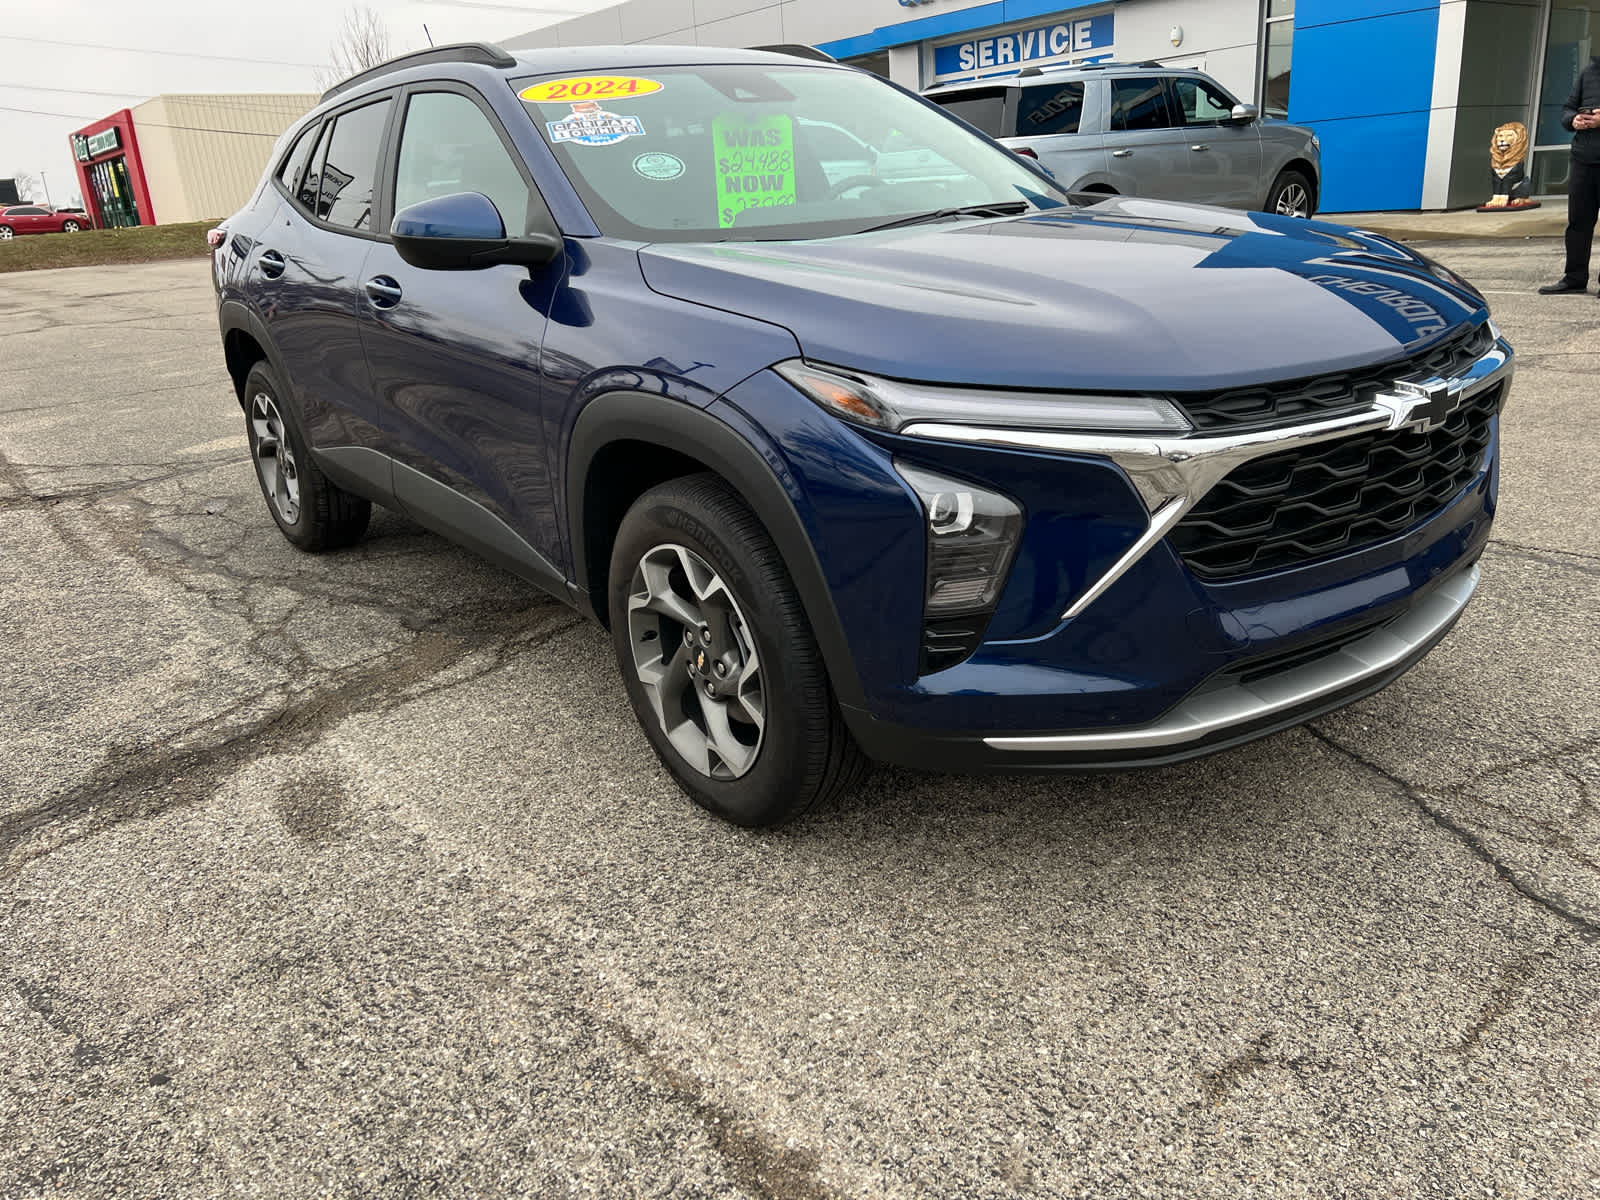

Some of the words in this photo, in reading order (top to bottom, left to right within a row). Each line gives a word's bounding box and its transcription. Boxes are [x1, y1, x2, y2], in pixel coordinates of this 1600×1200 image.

[959, 20, 1092, 70] SERVICE
[546, 79, 640, 100] 2024
[723, 129, 782, 147] WAS
[725, 174, 785, 192] NOW
